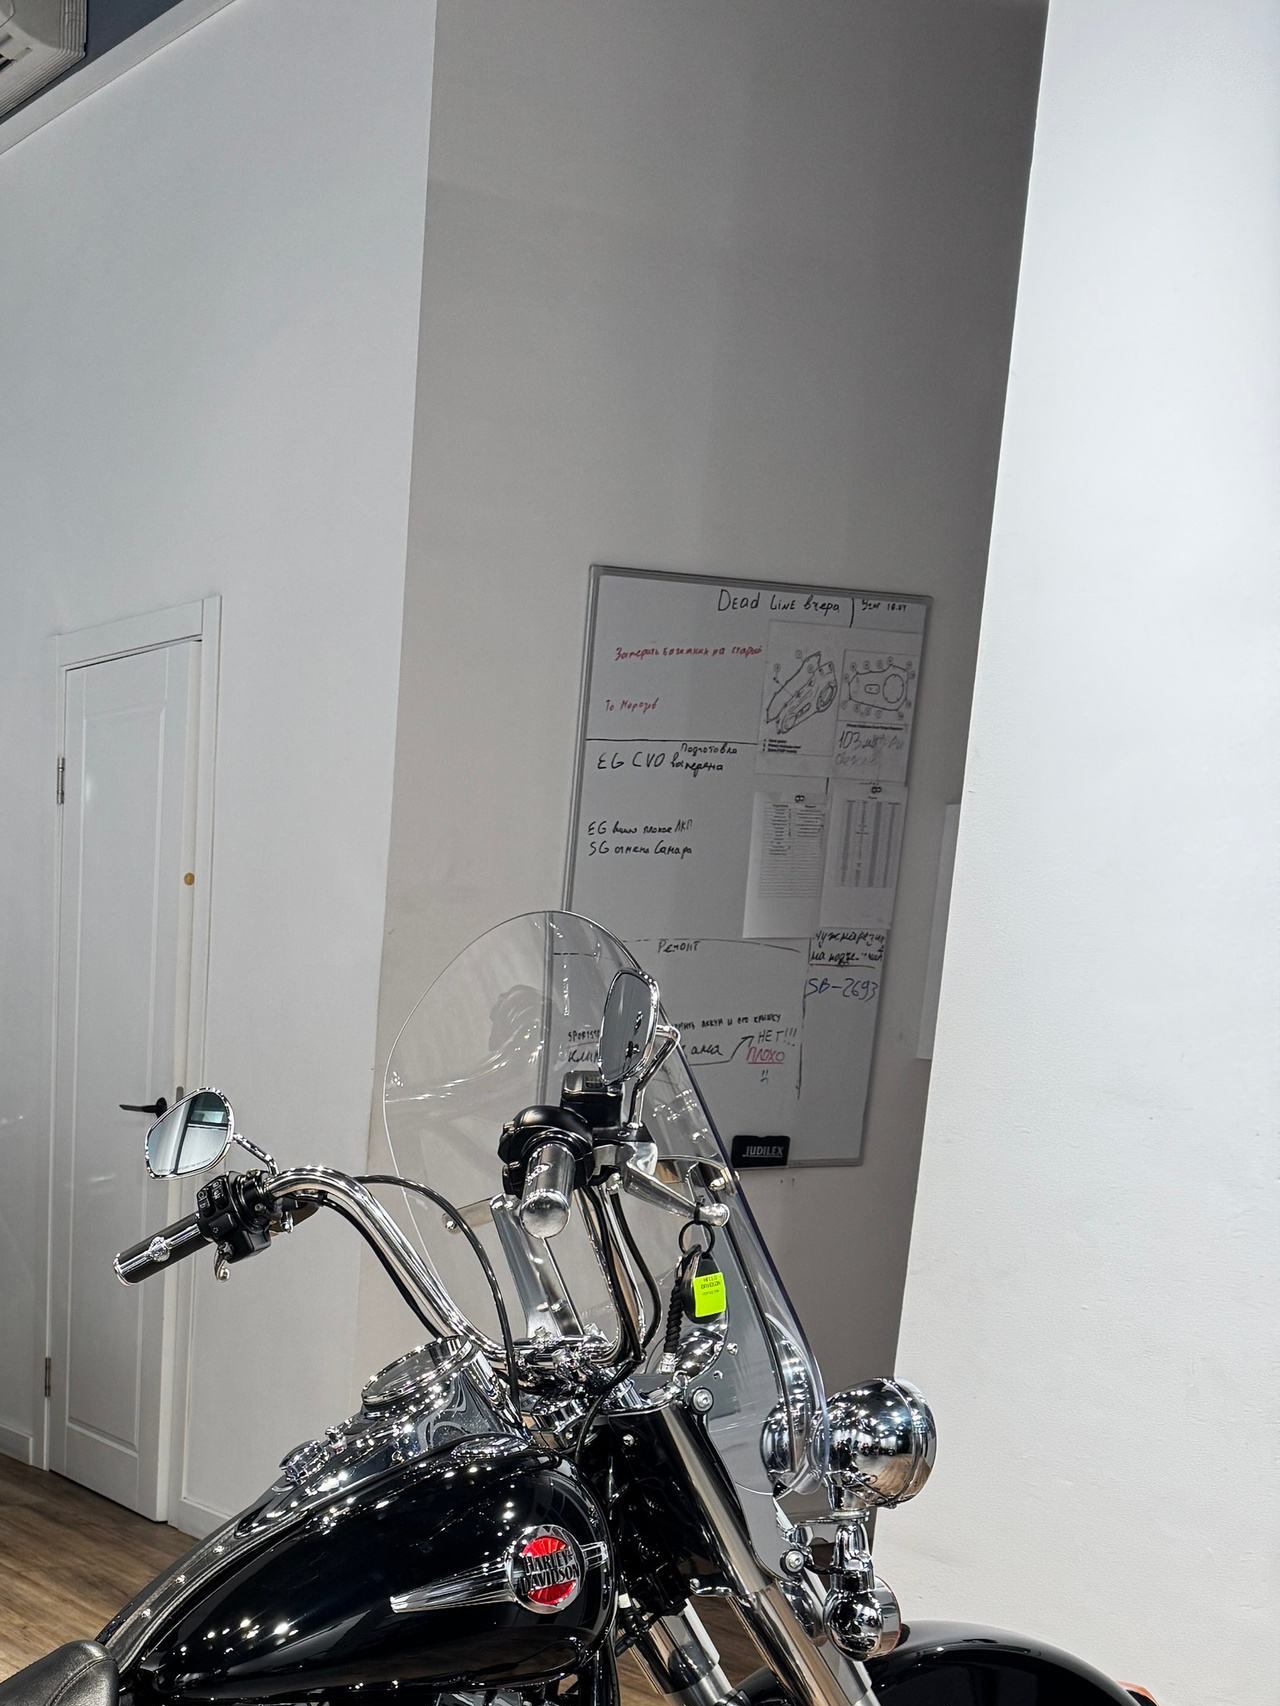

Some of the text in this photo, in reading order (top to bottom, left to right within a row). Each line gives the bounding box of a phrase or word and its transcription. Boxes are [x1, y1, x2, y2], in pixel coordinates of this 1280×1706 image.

[597, 752, 624, 769] EG
[632, 751, 665, 768] CVO
[587, 821, 607, 835] EG
[588, 840, 609, 856] SG
[804, 978, 878, 1002] SB-2693
[746, 1146, 784, 1155] JUDILEX
[520, 1563, 580, 1596] DAVIDSON
